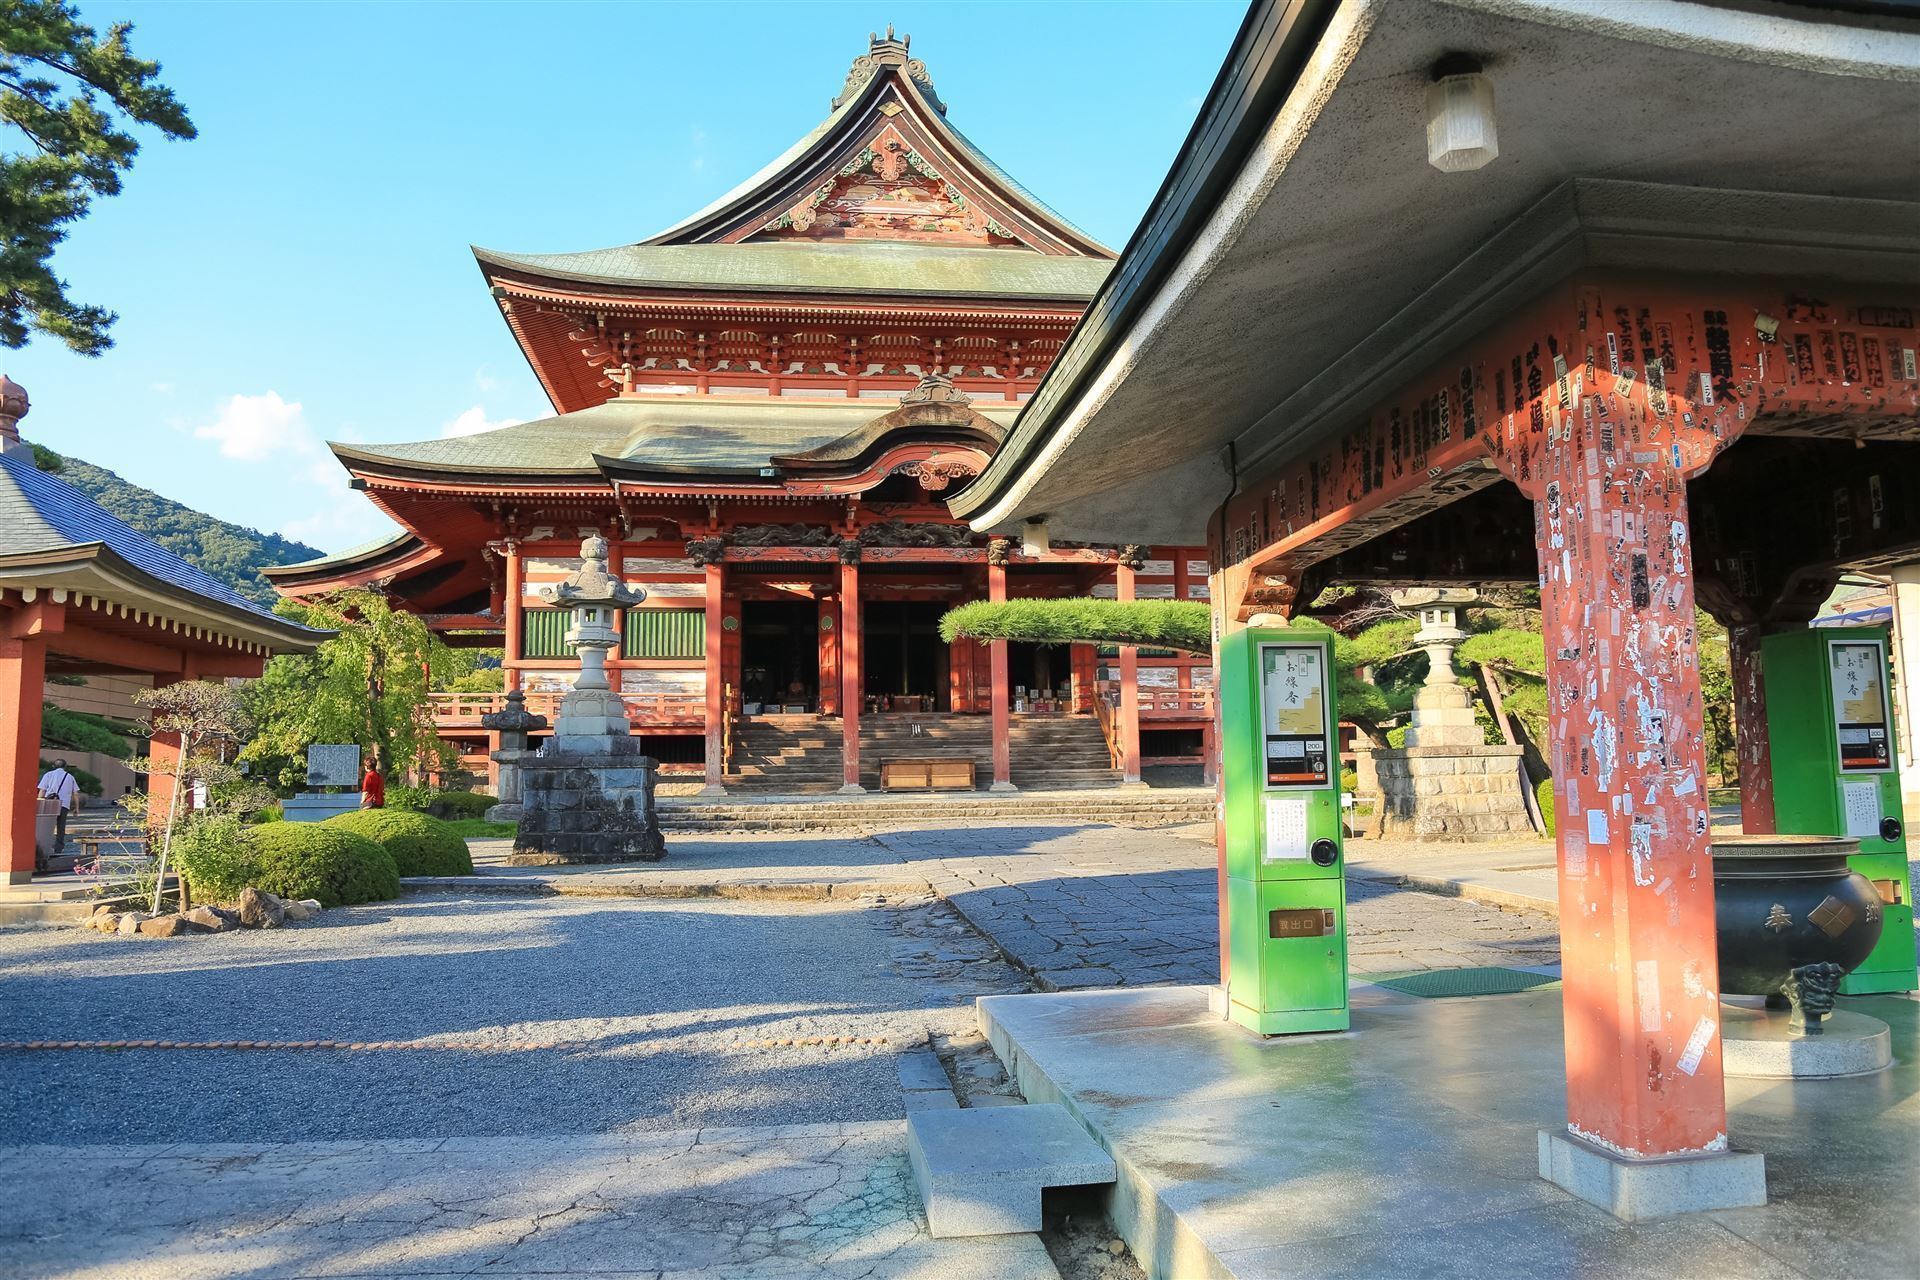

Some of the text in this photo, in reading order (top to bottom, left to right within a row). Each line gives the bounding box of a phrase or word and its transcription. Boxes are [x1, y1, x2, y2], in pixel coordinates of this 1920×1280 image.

[1285, 661, 1299, 704] お線香
[1847, 657, 1860, 696] お線香
[1764, 903, 1793, 934] 奉
